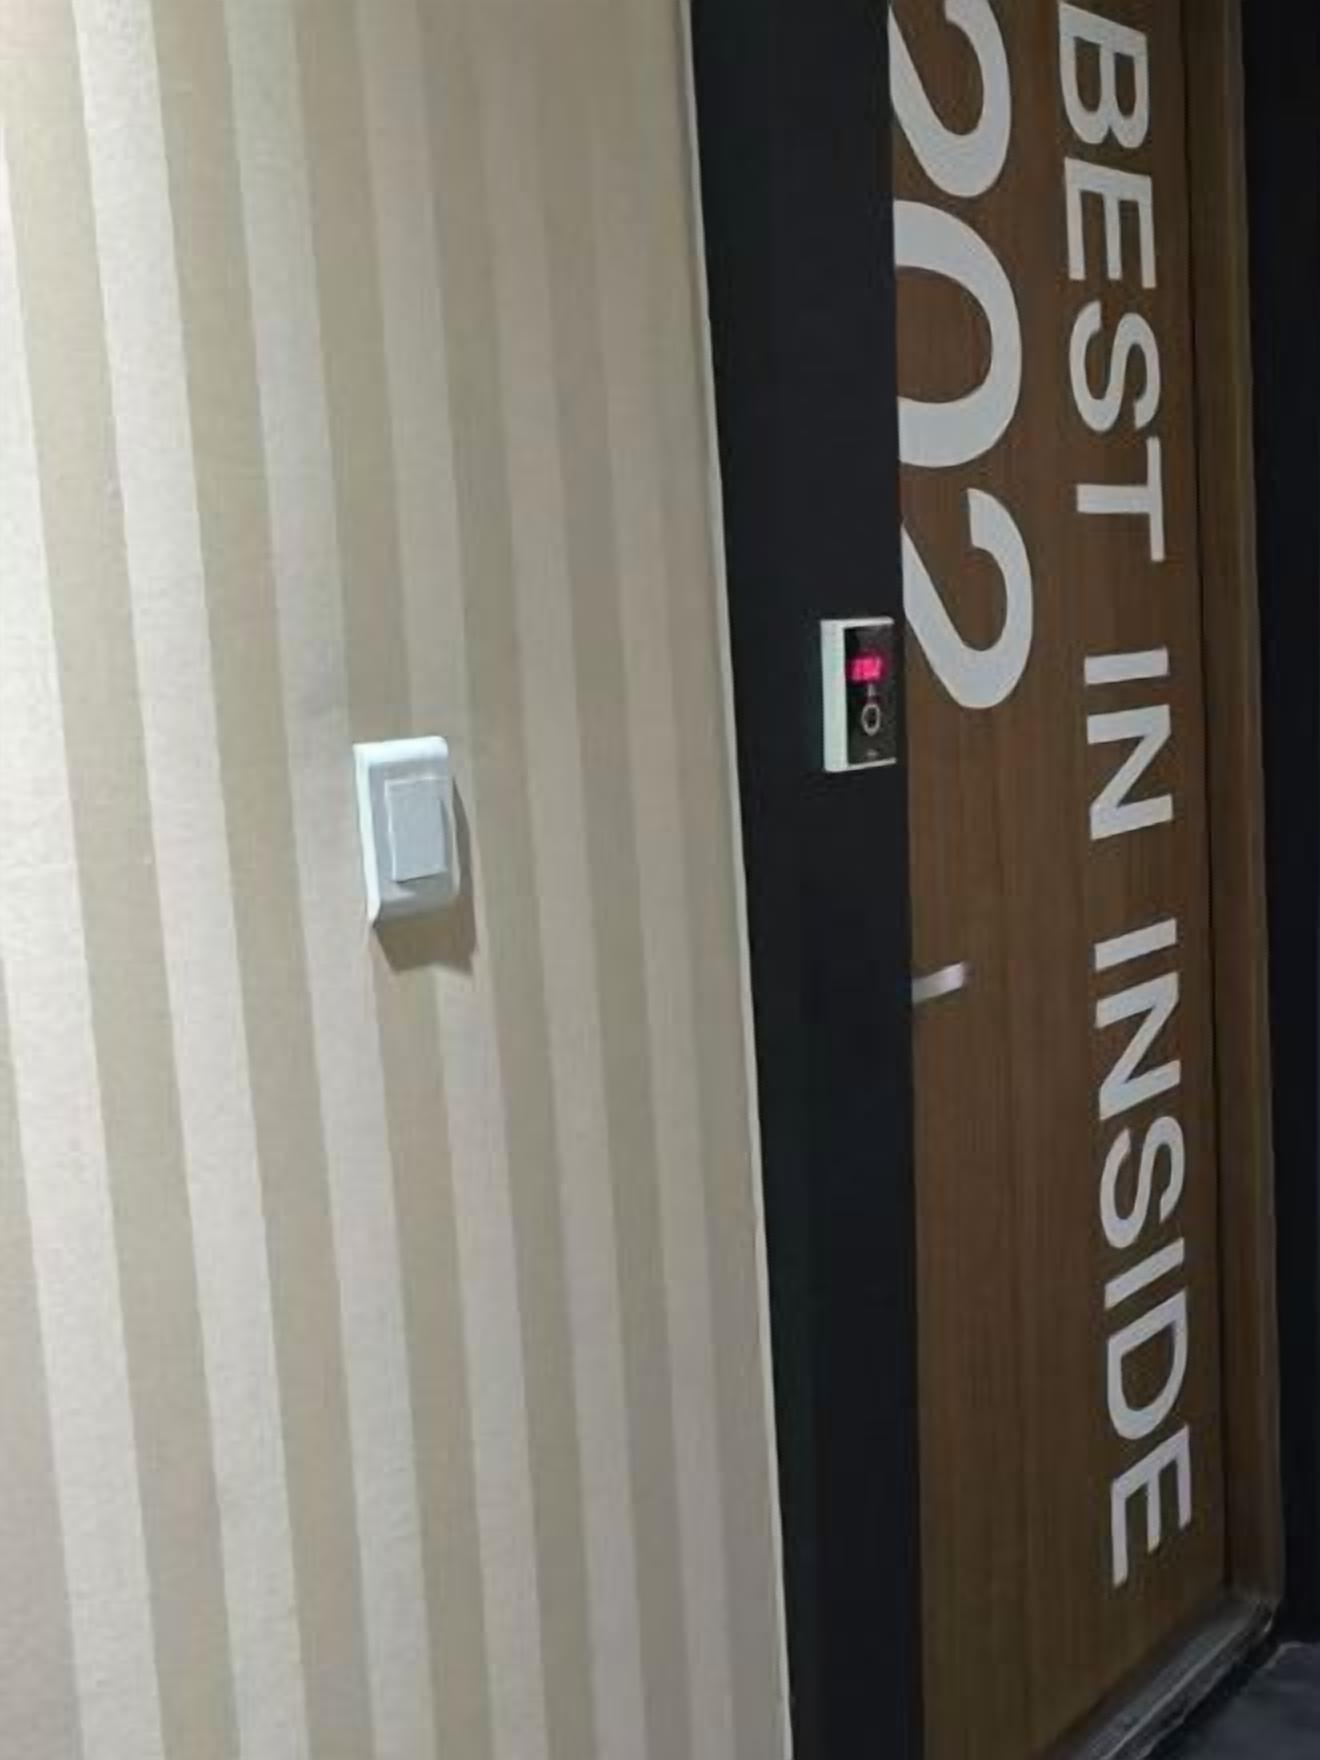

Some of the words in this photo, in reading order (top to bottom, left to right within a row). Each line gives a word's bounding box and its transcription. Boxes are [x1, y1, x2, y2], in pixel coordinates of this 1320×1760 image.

[887, 0, 1034, 710] 202
[1058, 0, 1165, 563] BEST
[1084, 647, 1173, 841] IN
[1093, 918, 1192, 1587] INSIDE
